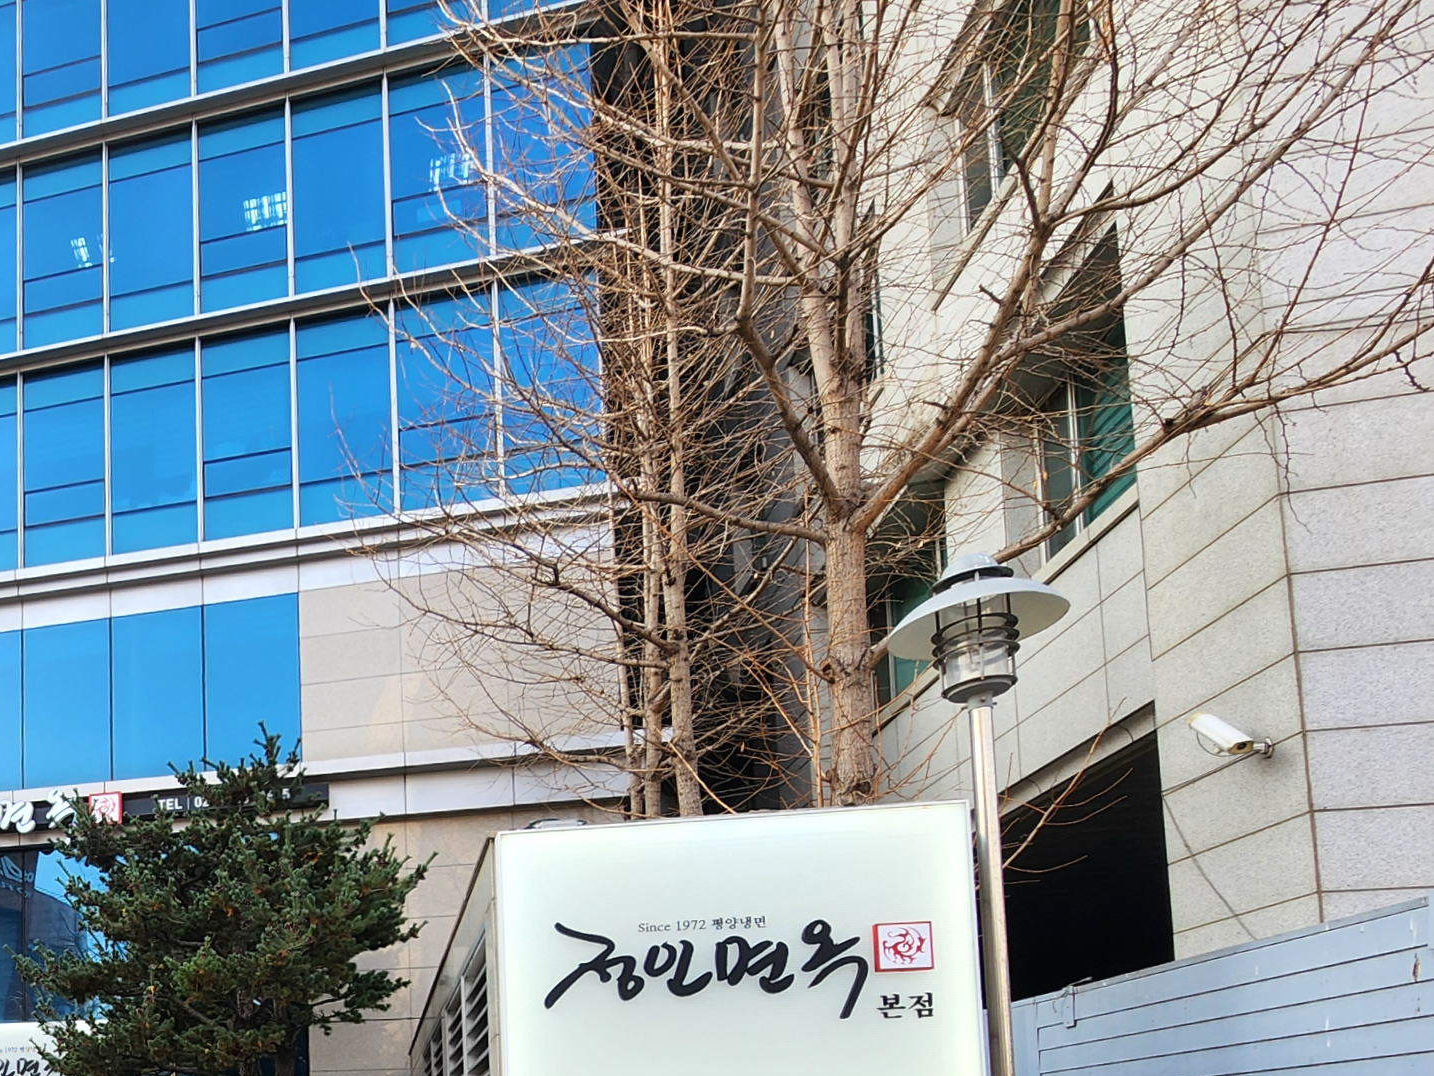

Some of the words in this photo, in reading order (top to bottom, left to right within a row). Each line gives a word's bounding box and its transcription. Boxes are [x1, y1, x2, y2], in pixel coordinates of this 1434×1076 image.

[157, 797, 183, 811] TEL
[638, 923, 671, 932] Since
[676, 920, 706, 931] 1972
[711, 915, 767, 930] 평양냉면
[544, 918, 870, 1020] 정인면옥
[876, 992, 935, 1019] 본점
